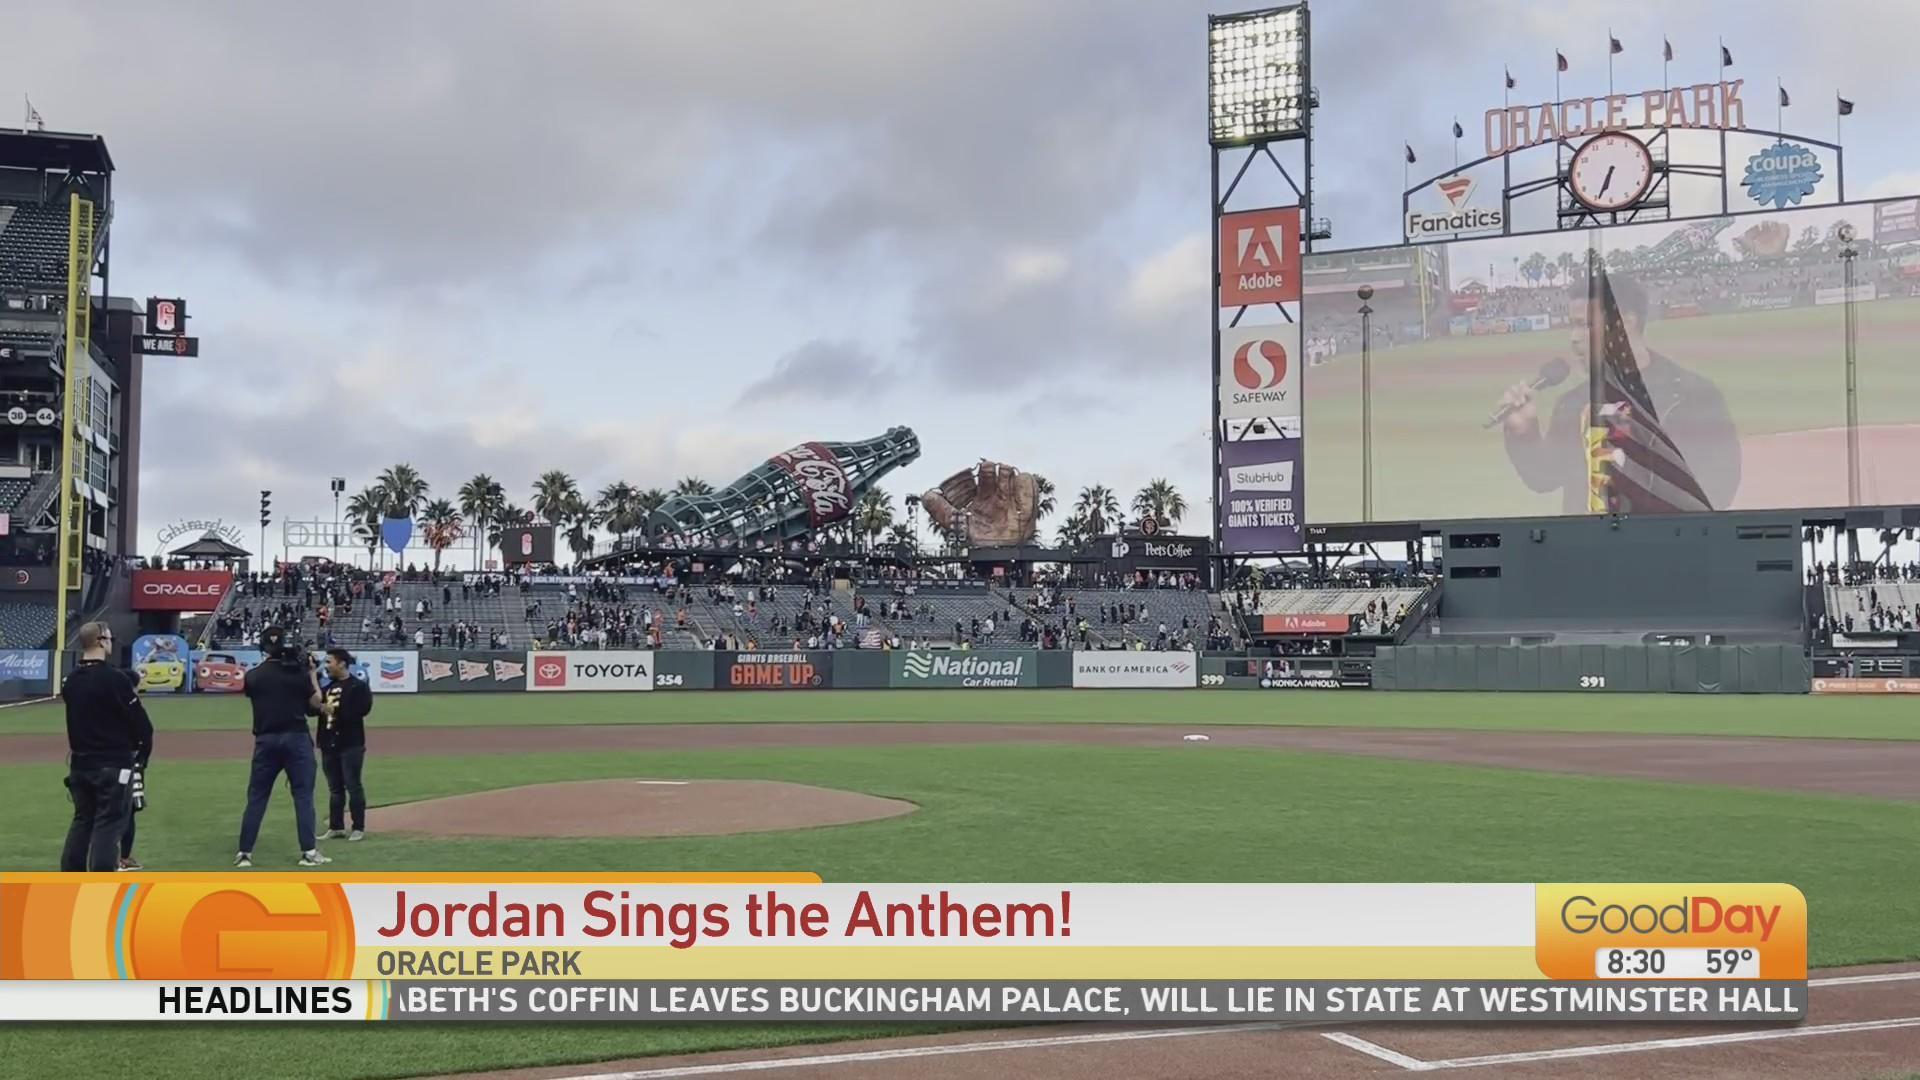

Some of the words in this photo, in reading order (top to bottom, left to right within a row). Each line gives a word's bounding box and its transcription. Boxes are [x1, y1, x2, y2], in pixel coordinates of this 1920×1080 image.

[1485, 94, 1627, 157] ORACLE
[1642, 79, 1746, 130] PARK
[1752, 153, 1814, 173] coupa
[1410, 209, 1501, 233] Fanatics
[1238, 273, 1283, 290] Adobe
[143, 339, 157, 350] WE
[158, 340, 175, 351] ARE
[1233, 391, 1287, 404] SAFEWAY
[1237, 472, 1284, 483] StubHub
[1231, 500, 1253, 513] 100%
[1254, 498, 1292, 512] VERIFIED
[1228, 514, 1258, 527] GIANTS
[1260, 513, 1295, 526] TICKETS
[157, 518, 246, 544] Ghirardelli
[1167, 543, 1192, 558] Coffee
[143, 584, 221, 595] ORACLE
[767, 654, 807, 663] BASEBALL
[573, 664, 648, 678] TOYOTA
[932, 656, 1022, 676] National
[1079, 666, 1106, 674] BANK
[1109, 666, 1121, 674] OF
[1123, 665, 1169, 674] AMERICA
[656, 674, 683, 686] 354
[731, 665, 782, 685] GAME
[789, 665, 814, 685] UP
[1201, 675, 1224, 686] 399
[963, 677, 980, 687] Car
[983, 677, 1018, 687] Rental
[1272, 680, 1303, 688] KONICA
[1304, 680, 1340, 688] MINOLTA
[1580, 676, 1605, 688] 391
